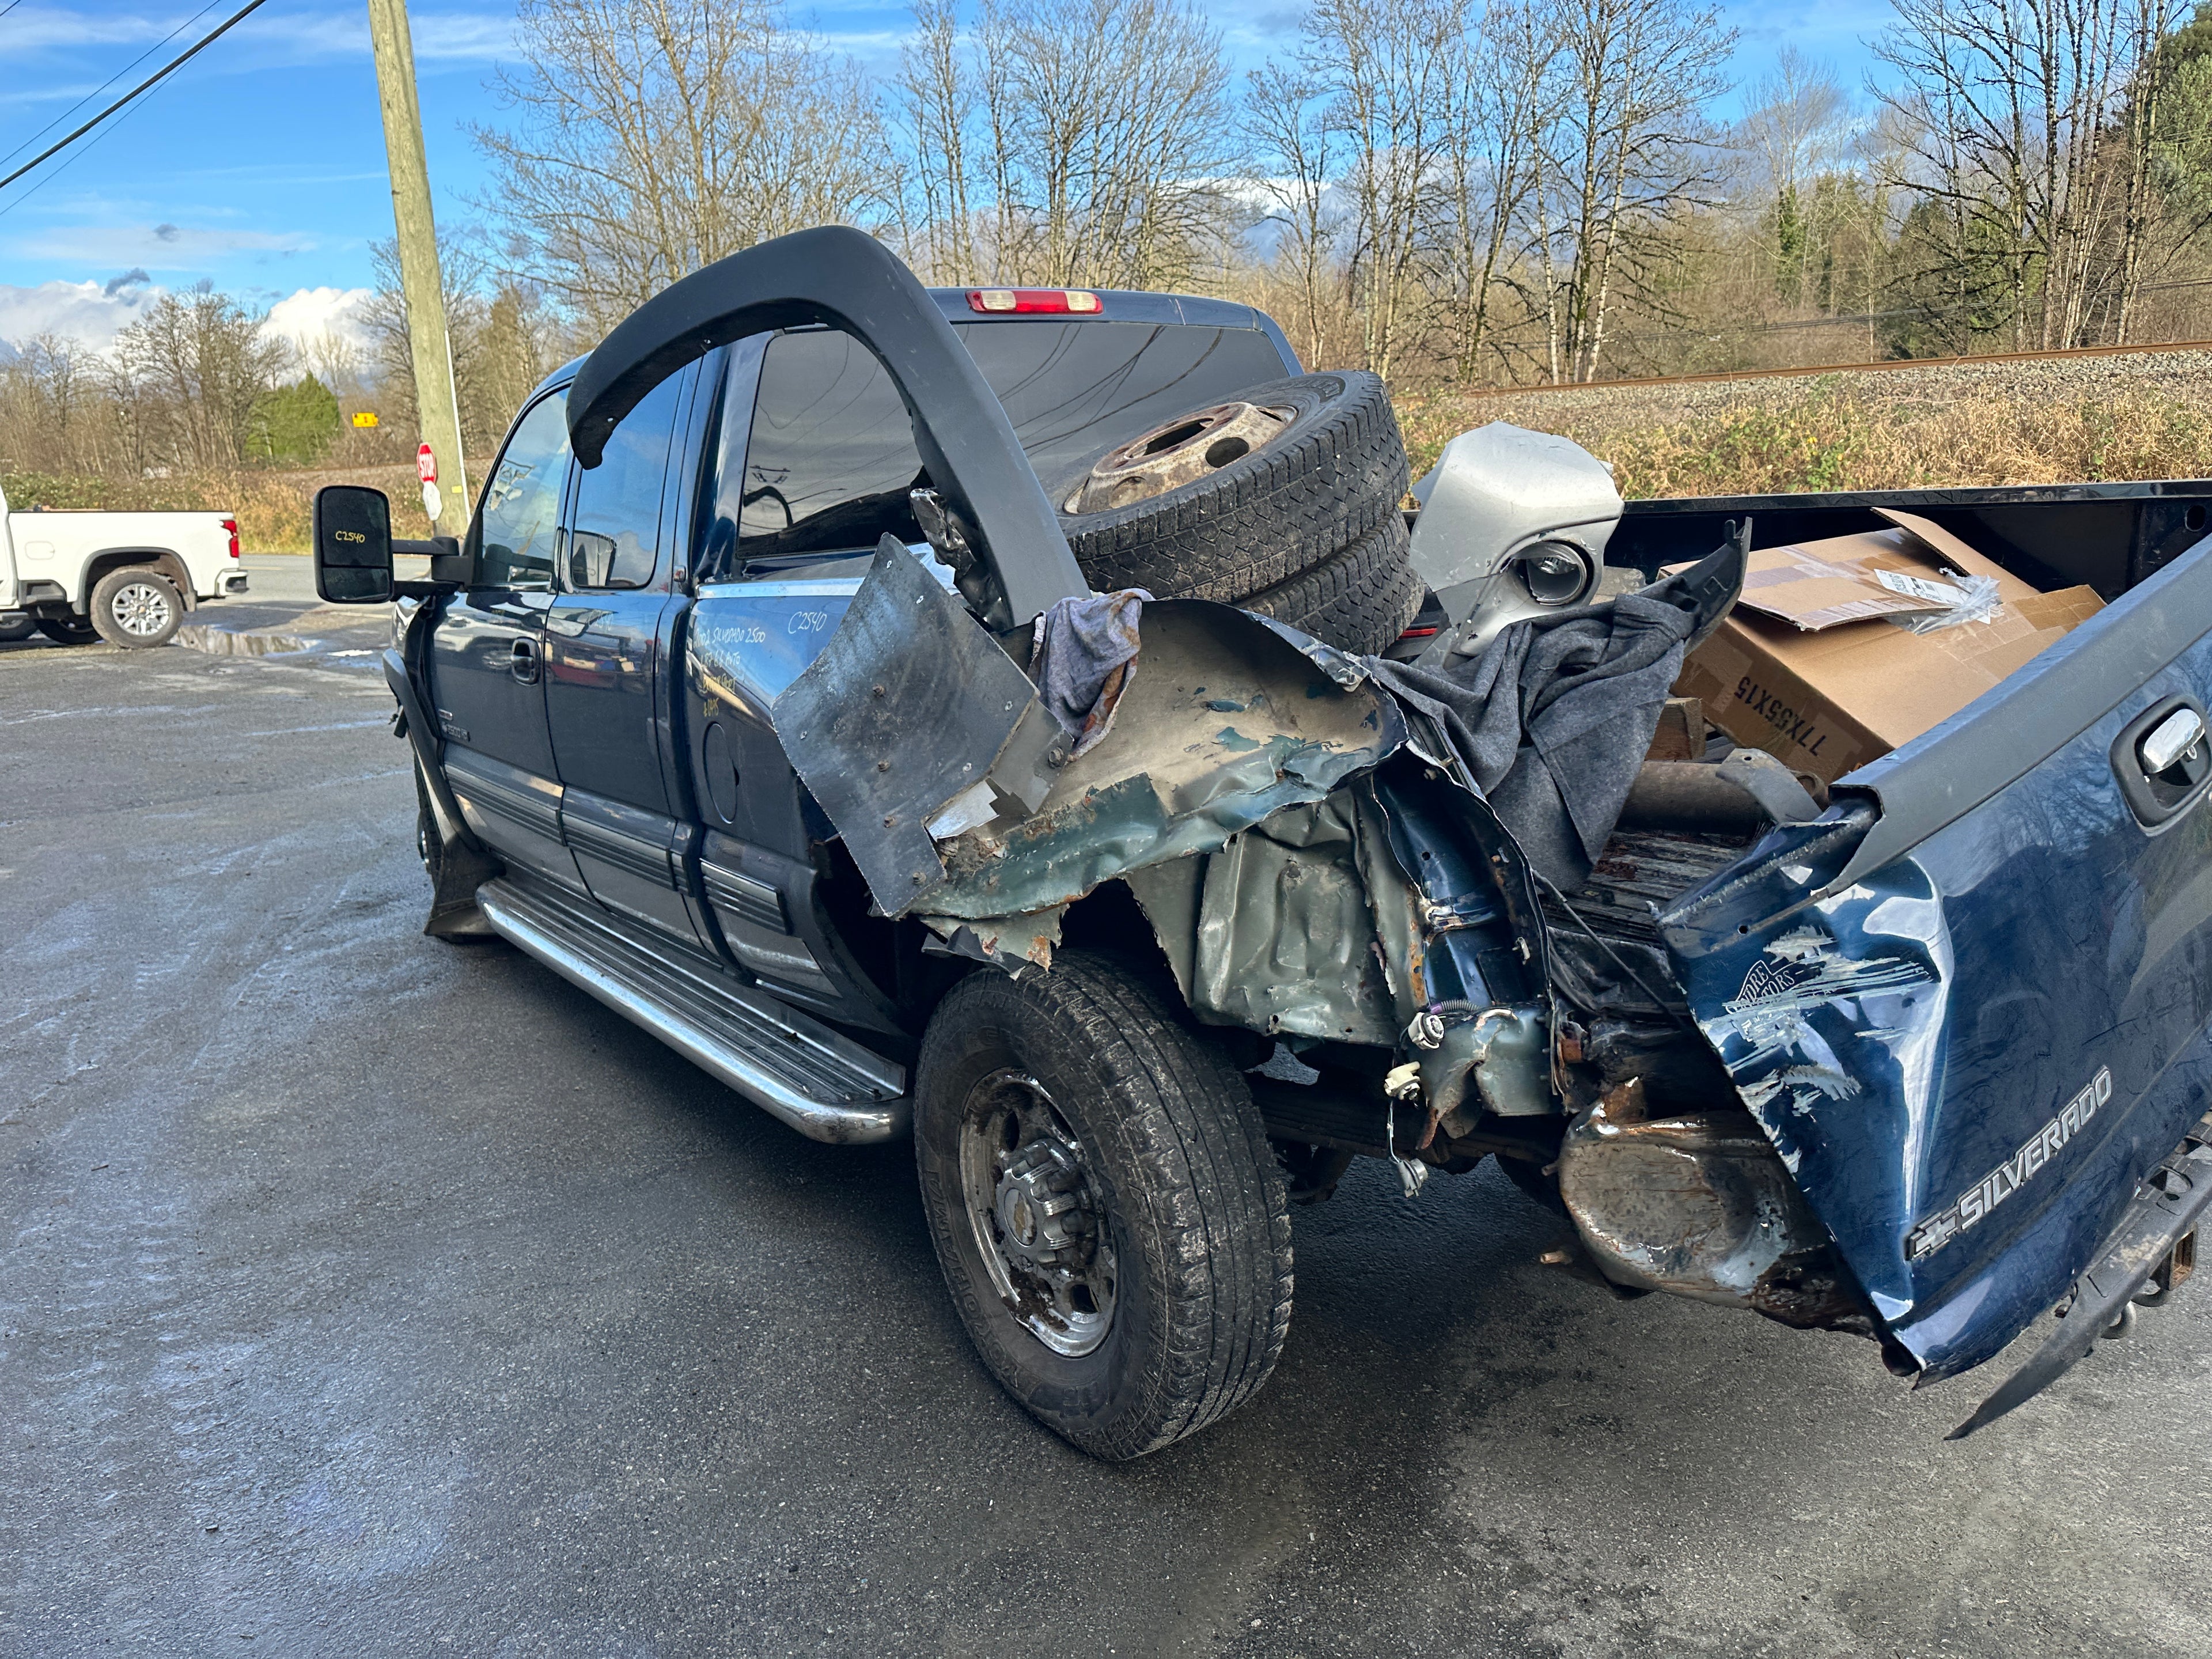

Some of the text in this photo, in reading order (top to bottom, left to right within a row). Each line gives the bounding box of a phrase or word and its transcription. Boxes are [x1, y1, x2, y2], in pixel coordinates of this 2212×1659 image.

[419, 453, 434, 478] STOP
[336, 531, 365, 543] C2540
[788, 611, 827, 634] C2540
[745, 627, 766, 643] 2500
[1734, 676, 1826, 756] 77X55X15
[1960, 1068, 2112, 1230] SILVERADO
